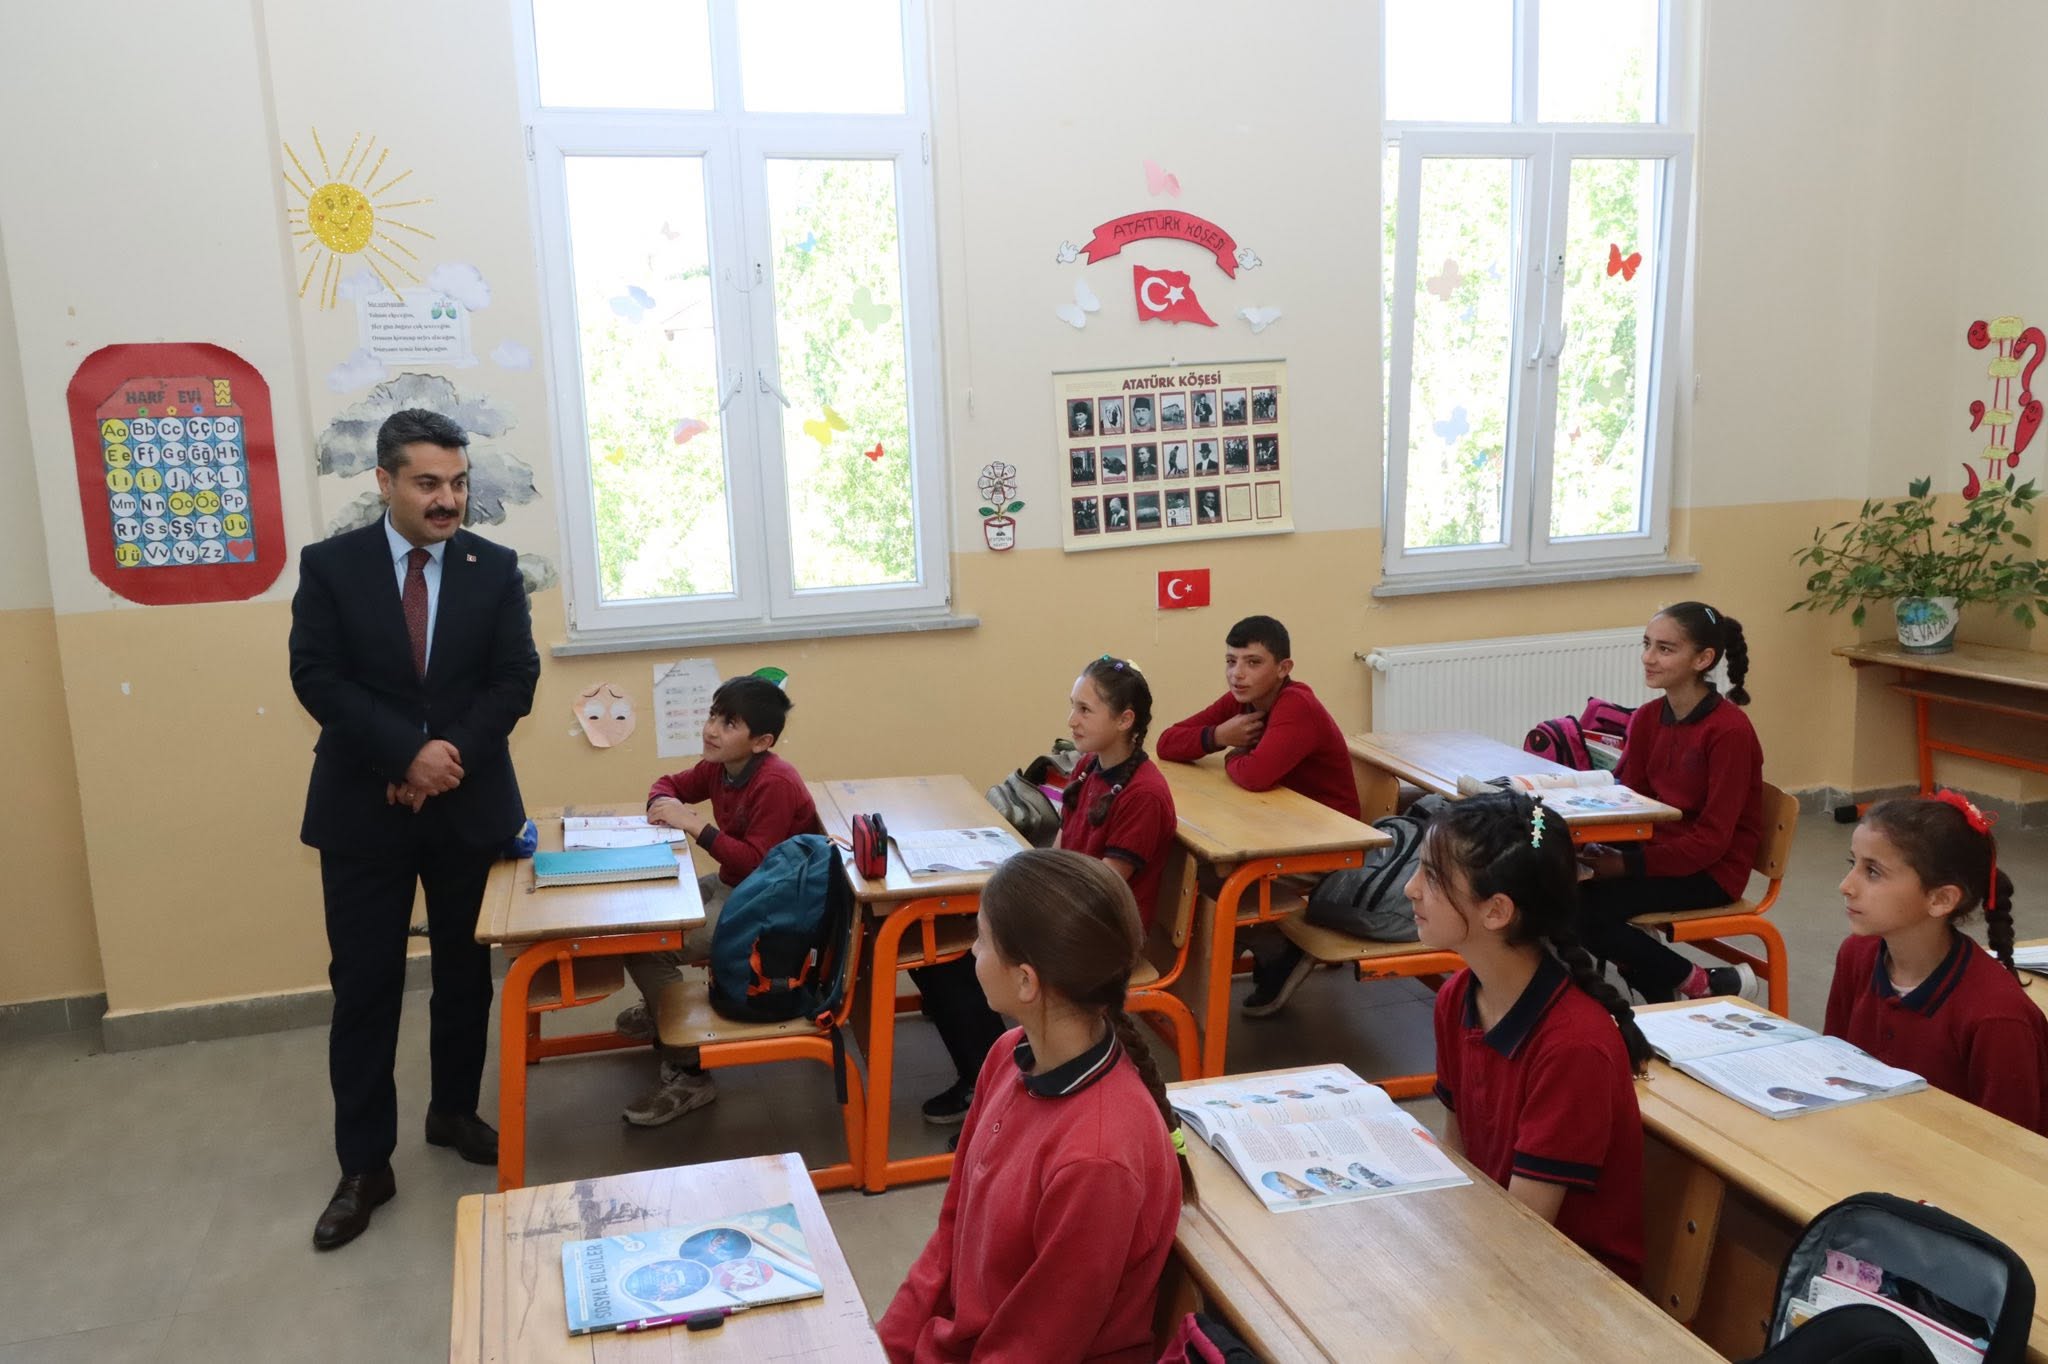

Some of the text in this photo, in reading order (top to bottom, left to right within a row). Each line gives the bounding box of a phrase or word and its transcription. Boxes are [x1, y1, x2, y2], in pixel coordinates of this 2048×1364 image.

[1122, 374, 1176, 391] ATATÜRK
[1178, 370, 1222, 388] KÖŞESİ
[125, 390, 166, 404] HARF
[585, 1243, 612, 1320] SOSYAL BİLGİLER
